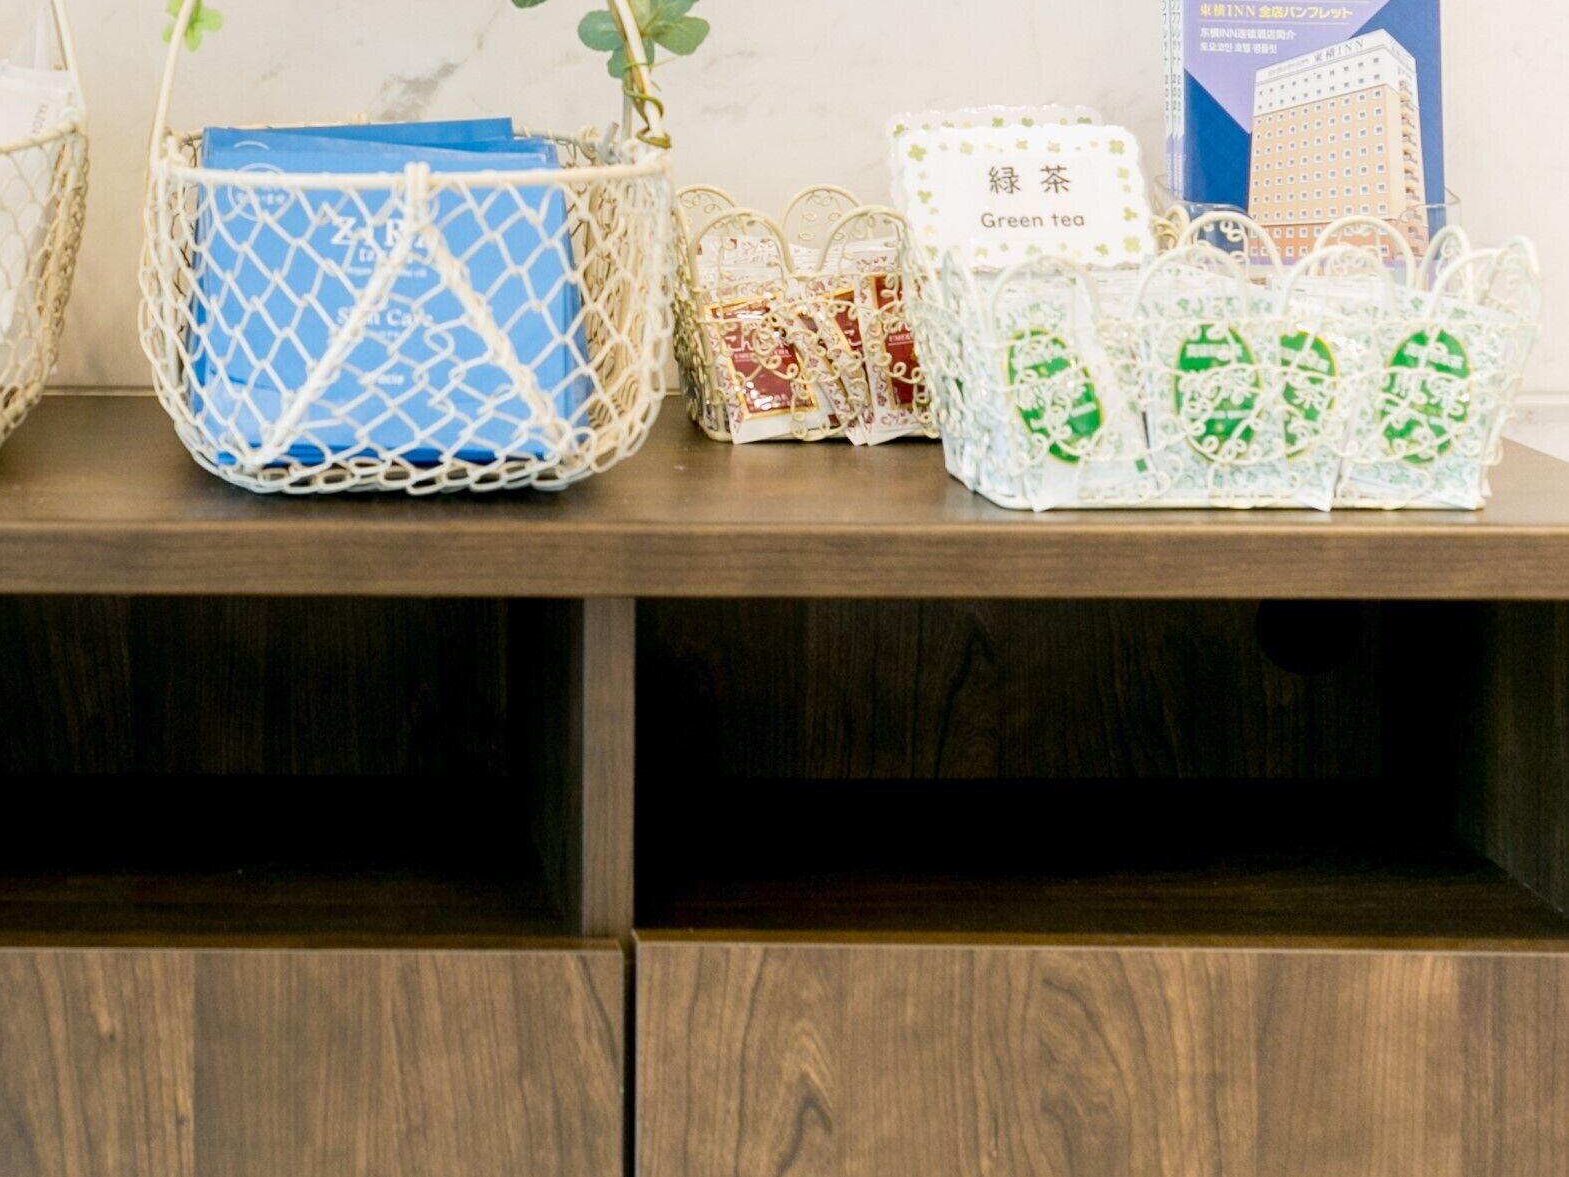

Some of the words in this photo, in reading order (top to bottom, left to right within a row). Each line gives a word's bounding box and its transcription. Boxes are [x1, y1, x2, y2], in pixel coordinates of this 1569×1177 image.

[988, 164, 1071, 194] 緑茶
[981, 213, 1043, 228] Green
[1052, 213, 1085, 228] tea
[337, 306, 380, 327] Sn
[386, 308, 434, 328] Cae
